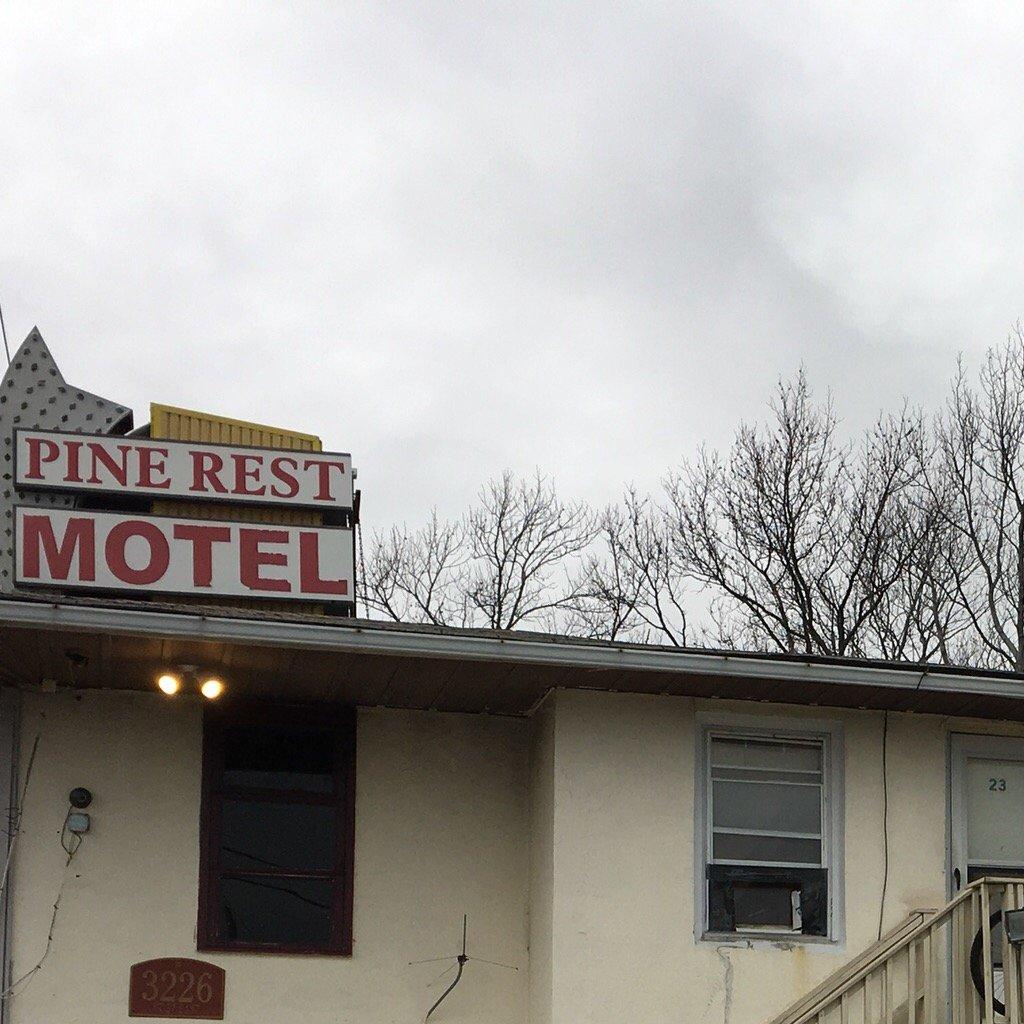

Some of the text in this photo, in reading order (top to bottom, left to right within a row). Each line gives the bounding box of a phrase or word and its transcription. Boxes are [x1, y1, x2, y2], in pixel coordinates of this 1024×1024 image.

[25, 437, 345, 501] PINE REST
[23, 514, 348, 596] MOTEL
[988, 778, 1007, 792] 23
[142, 970, 212, 1003] 3226
